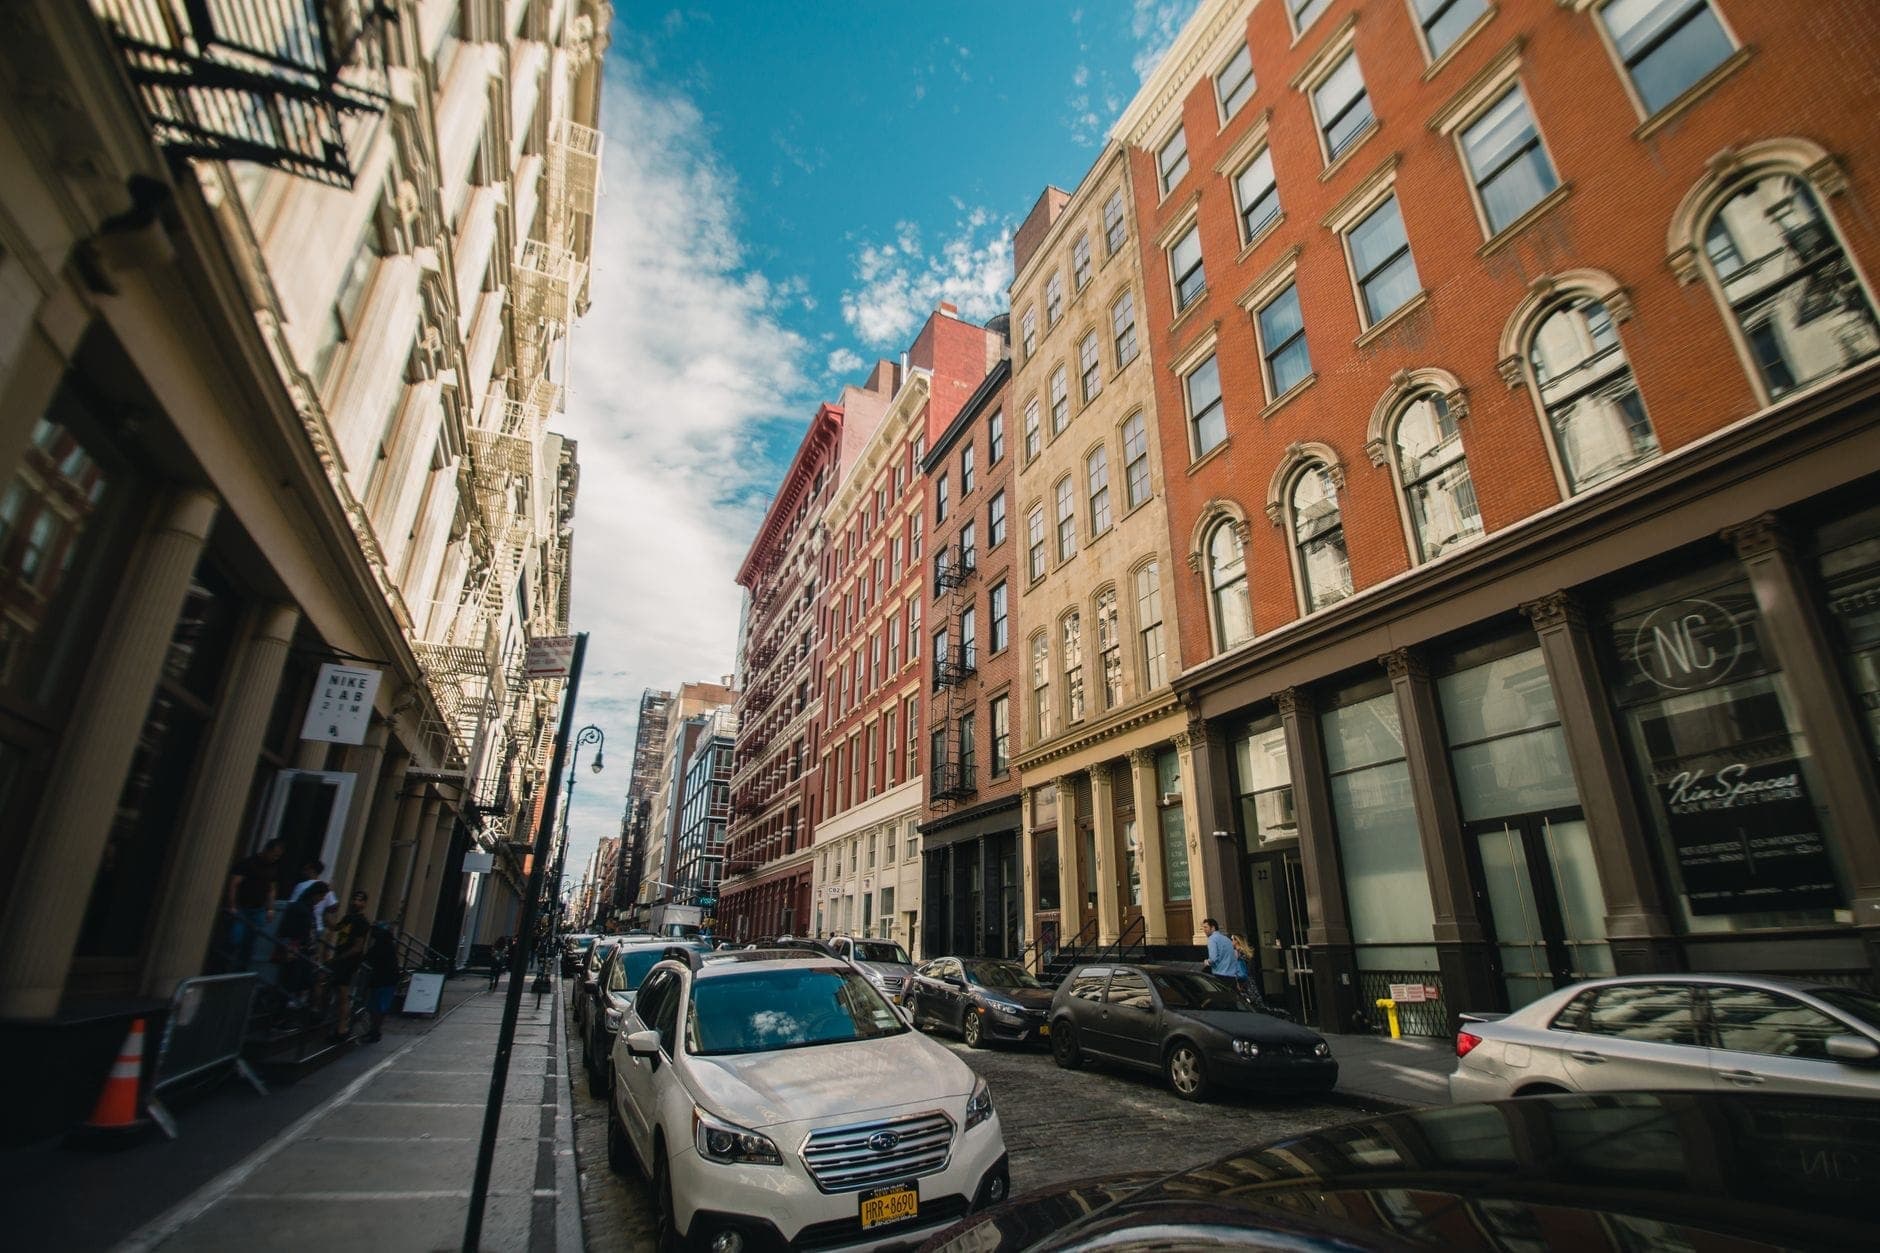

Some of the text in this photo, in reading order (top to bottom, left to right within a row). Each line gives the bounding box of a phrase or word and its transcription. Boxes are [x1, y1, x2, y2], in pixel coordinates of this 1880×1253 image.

[532, 638, 574, 649] NO PARKING
[1653, 614, 1716, 679] NC
[328, 674, 368, 689] NIKE
[324, 688, 364, 702] LAB
[1668, 763, 1799, 808] Kin Spaces
